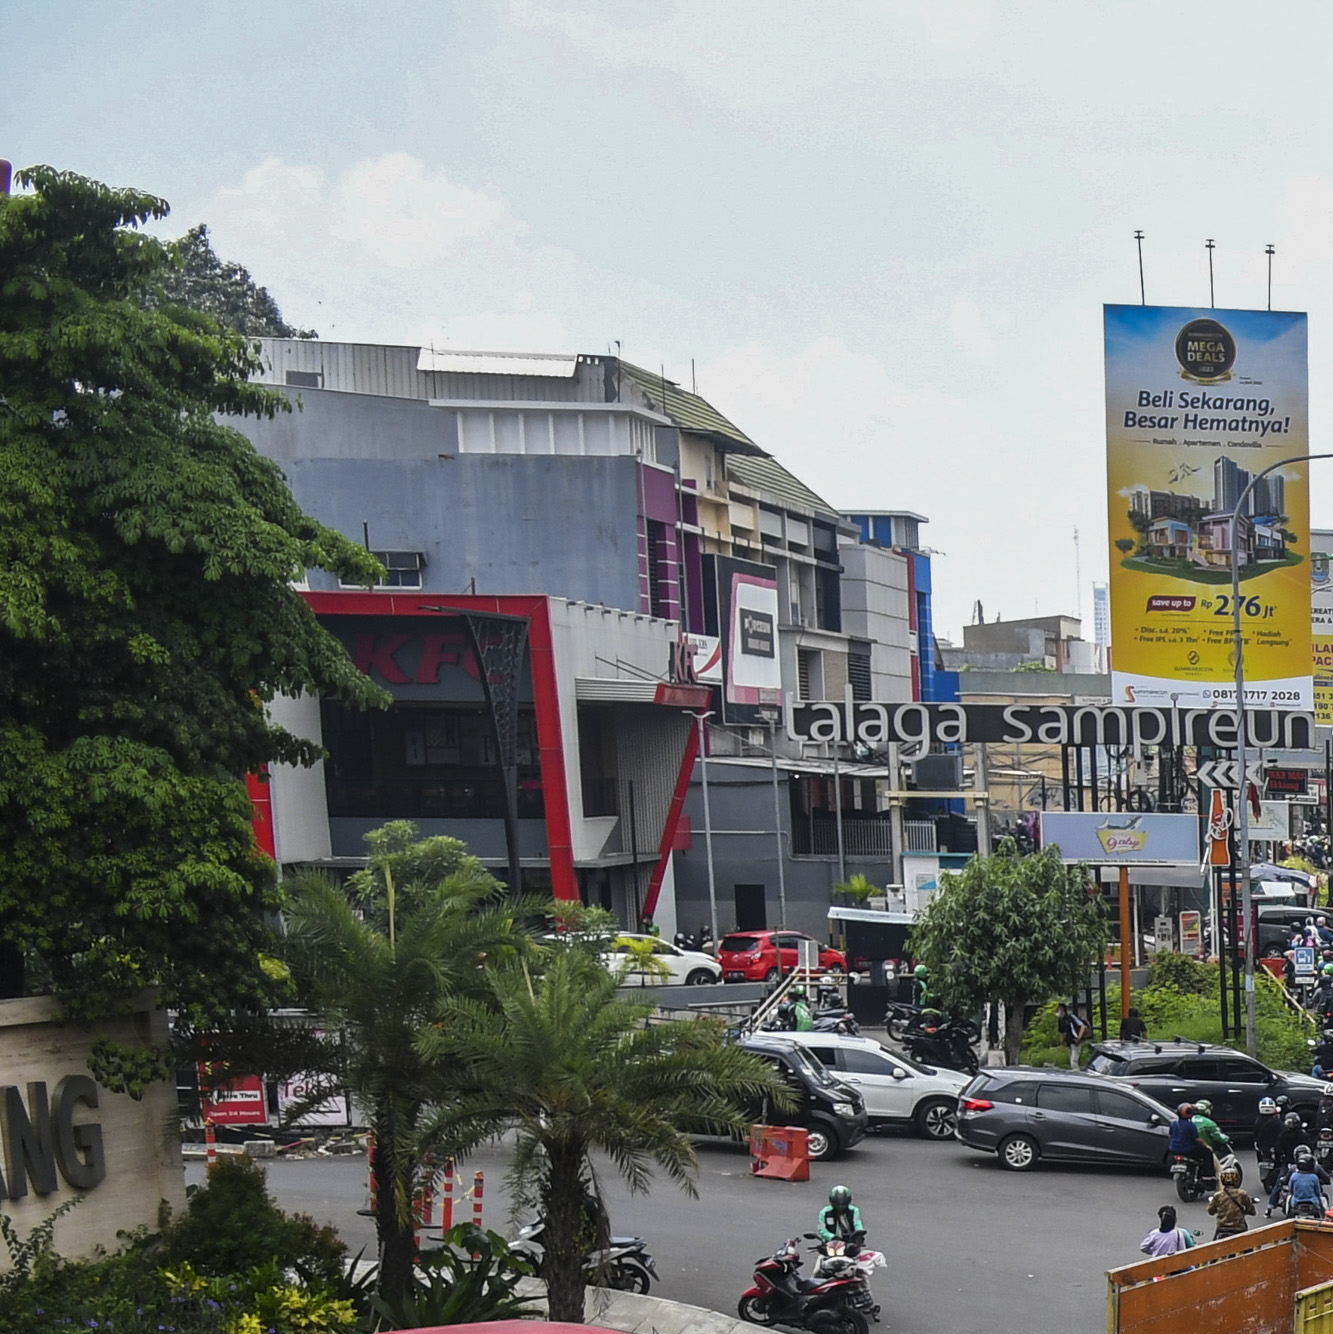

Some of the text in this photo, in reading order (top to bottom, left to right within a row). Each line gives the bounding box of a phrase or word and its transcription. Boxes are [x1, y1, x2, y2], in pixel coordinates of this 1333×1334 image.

[1187, 341, 1225, 352] MEGA
[1187, 352, 1225, 363] DEALS
[1137, 390, 1276, 416] Beli Sekarang,
[1123, 411, 1291, 437] Besar Hematnya!
[1183, 439, 1221, 448] Apartemen
[1171, 600, 1183, 609] up
[1183, 599, 1192, 607] to
[1201, 600, 1213, 610] Rp
[1208, 629, 1224, 637] Free
[352, 632, 514, 685] KFC
[1213, 689, 1238, 699] 0817
[1271, 691, 1301, 700] 2028
[785, 684, 1316, 762] talaga sampireun
[0, 1074, 106, 1200] NG
